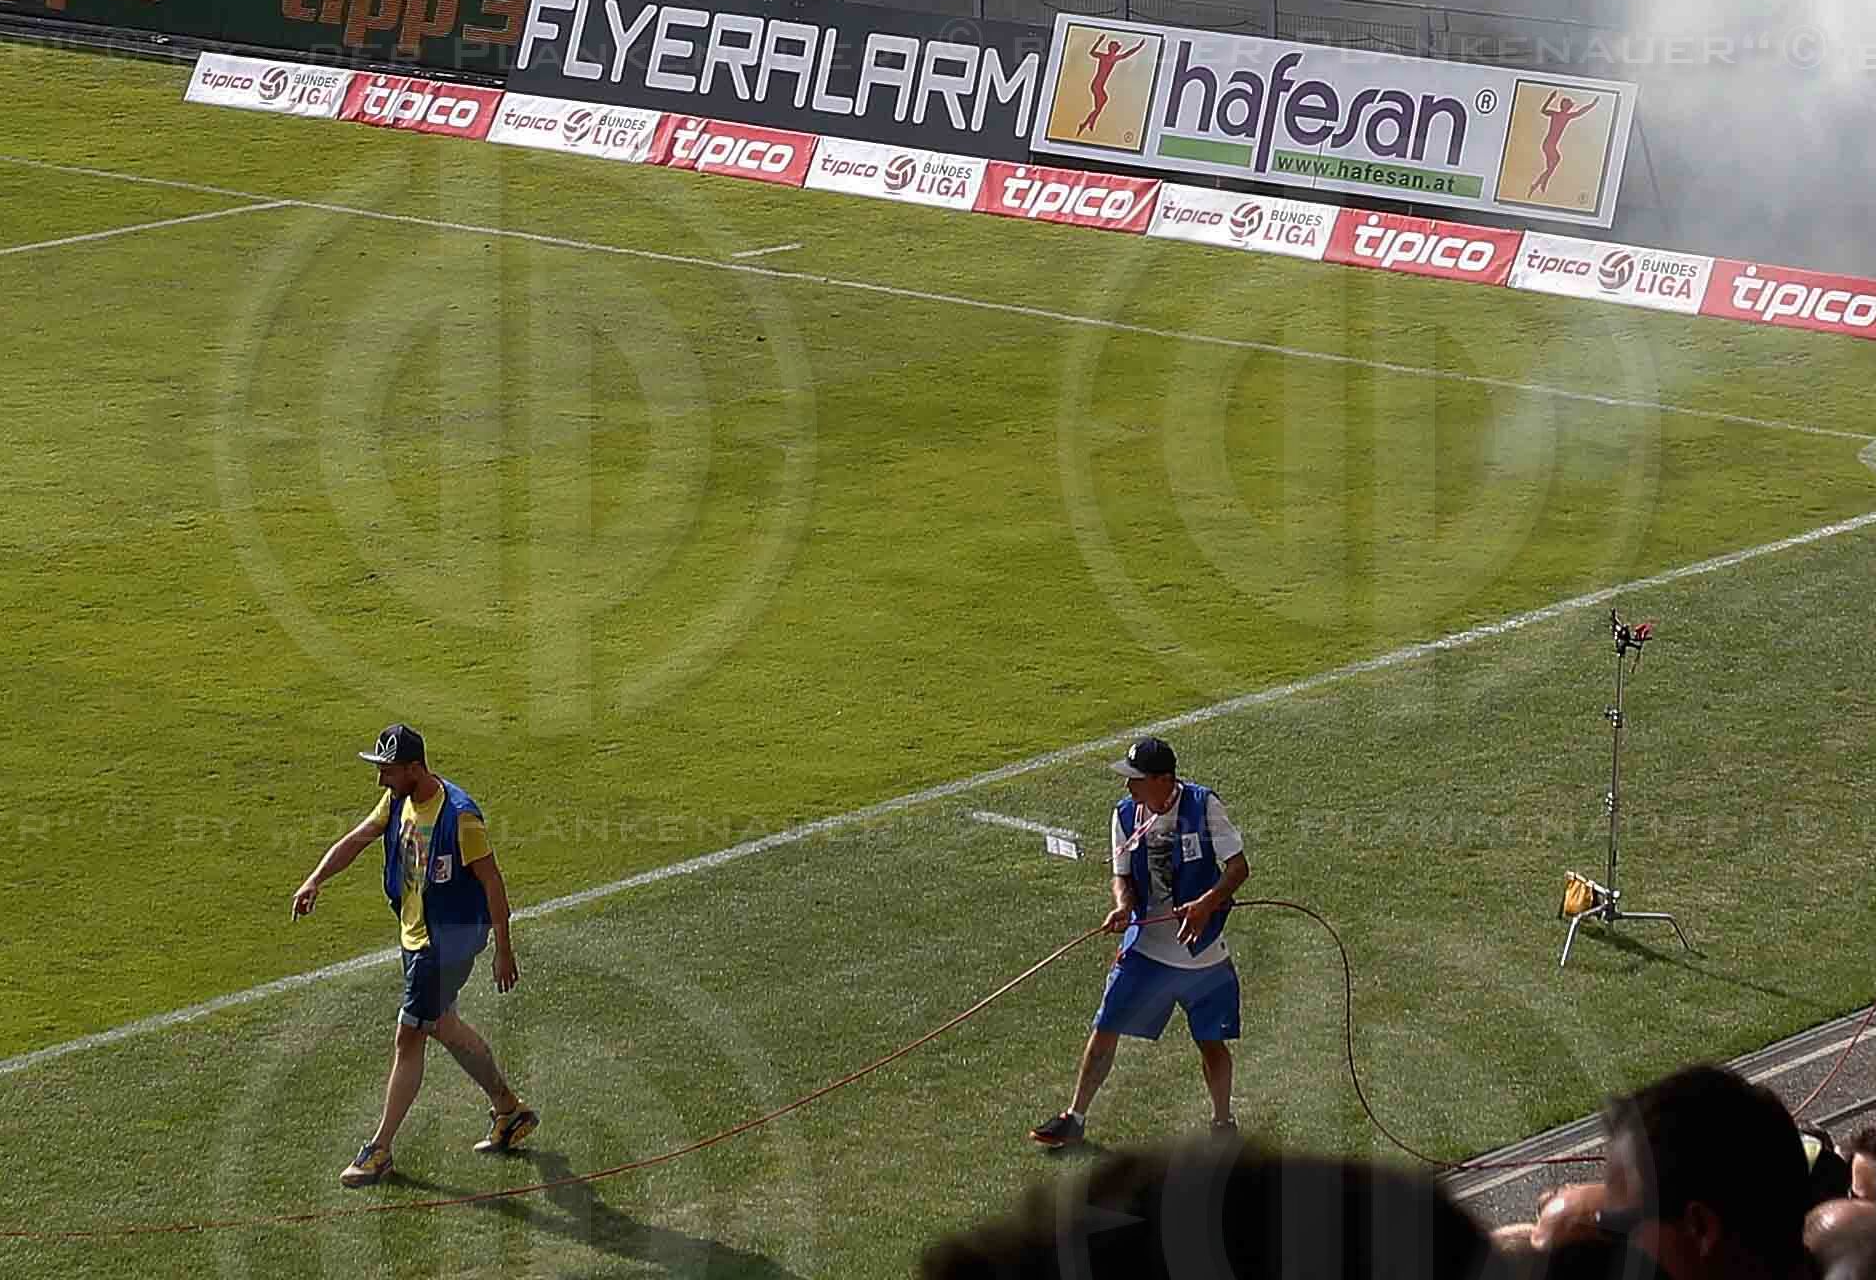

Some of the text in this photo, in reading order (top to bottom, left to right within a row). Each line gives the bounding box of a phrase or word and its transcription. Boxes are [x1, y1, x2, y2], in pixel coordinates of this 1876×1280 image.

[201, 67, 253, 91] tipico
[294, 74, 339, 89] BUNDES
[288, 86, 333, 105] LIGA
[362, 74, 479, 130] tipico
[1163, 42, 1466, 173] hafesan
[504, 107, 558, 131] tipico
[599, 115, 647, 130] BUNDES
[593, 128, 644, 151] LIGA
[672, 119, 794, 176] tipico
[820, 153, 878, 180] tipico
[923, 163, 973, 181] BUNDES
[1276, 152, 1456, 193] www.hafesan.at
[915, 176, 967, 200] LIGA
[1001, 167, 1134, 220] tipico
[1162, 201, 1223, 227] tipico
[1270, 209, 1323, 228] BUNDES
[1263, 220, 1317, 248] LIGA
[1353, 214, 1493, 272] tipico
[1527, 247, 1591, 276] tipico
[1641, 258, 1697, 278] BUNDES
[1635, 273, 1694, 301] LIGA
